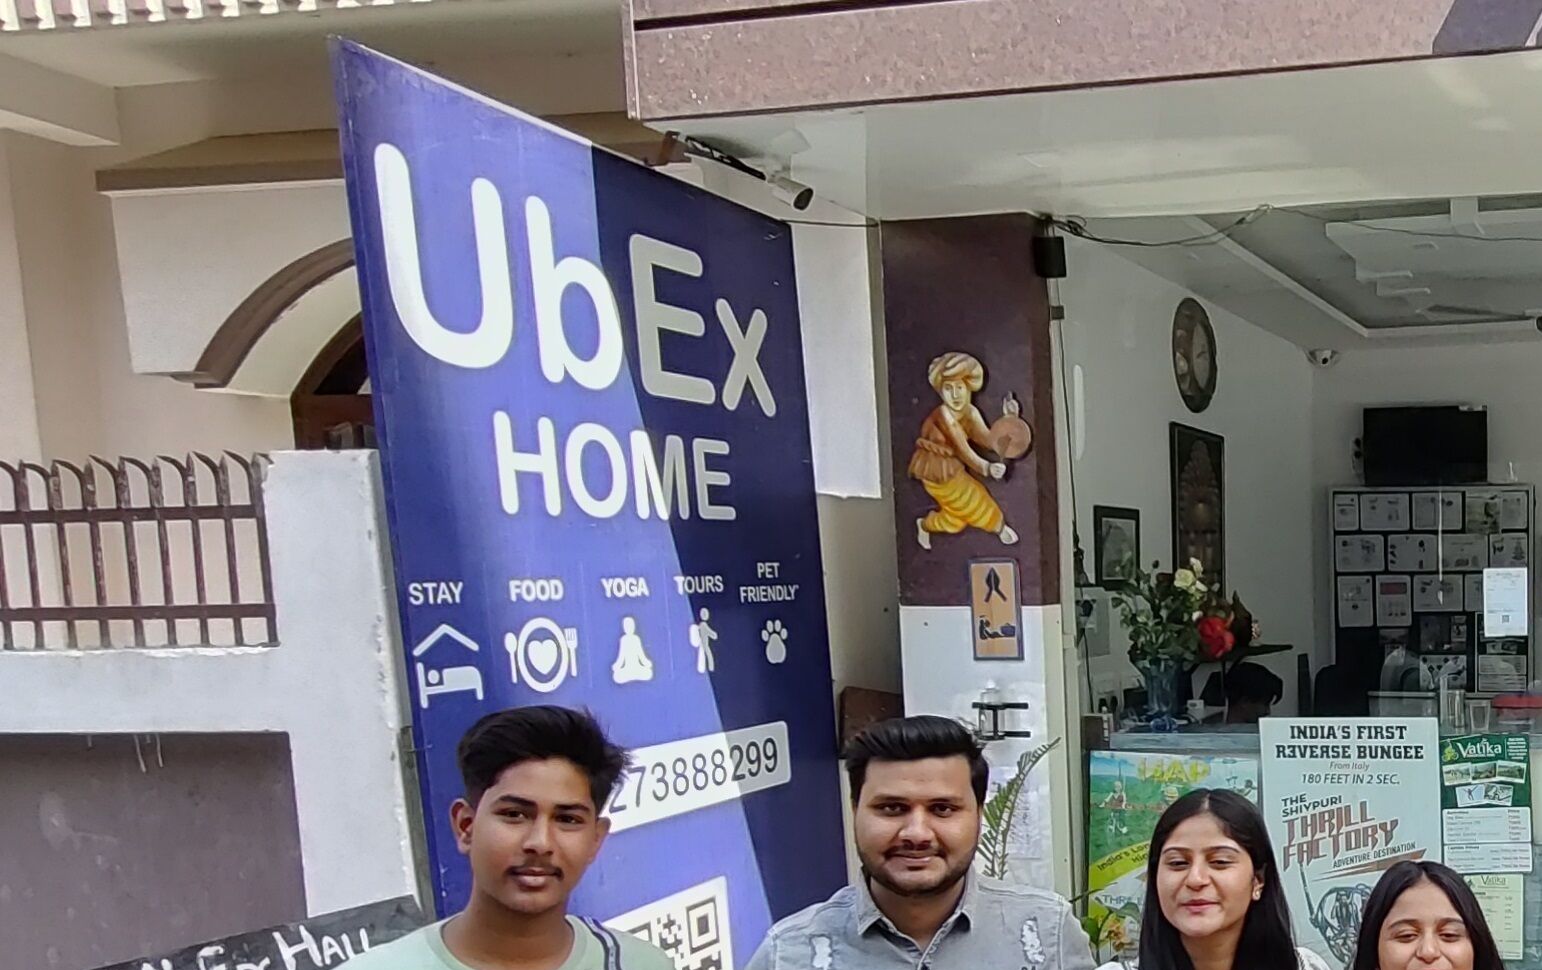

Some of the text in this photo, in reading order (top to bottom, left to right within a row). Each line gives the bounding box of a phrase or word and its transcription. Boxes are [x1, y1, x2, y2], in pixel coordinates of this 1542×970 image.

[493, 410, 737, 522] HOME
[757, 562, 780, 578] PET
[408, 582, 464, 605] STAY
[509, 579, 564, 602] FOOD
[601, 577, 649, 598] YOGA
[673, 575, 724, 595] TOURS
[739, 584, 799, 603] FRIENDLY
[1289, 725, 1408, 740] INDIA'S FIRST
[1356, 744, 1424, 760] BUNGEE
[1457, 738, 1502, 758] Vatika
[1329, 761, 1370, 772] From Italy
[1302, 774, 1401, 785] 180 FEET IN 2 SEC.
[1281, 793, 1308, 808] THE
[1281, 795, 1342, 818] SHIVPURI
[1282, 801, 1376, 847] THRILL
[1283, 819, 1399, 872] FACTORY
[1333, 842, 1416, 869] ADVENTURE DESTINATION
